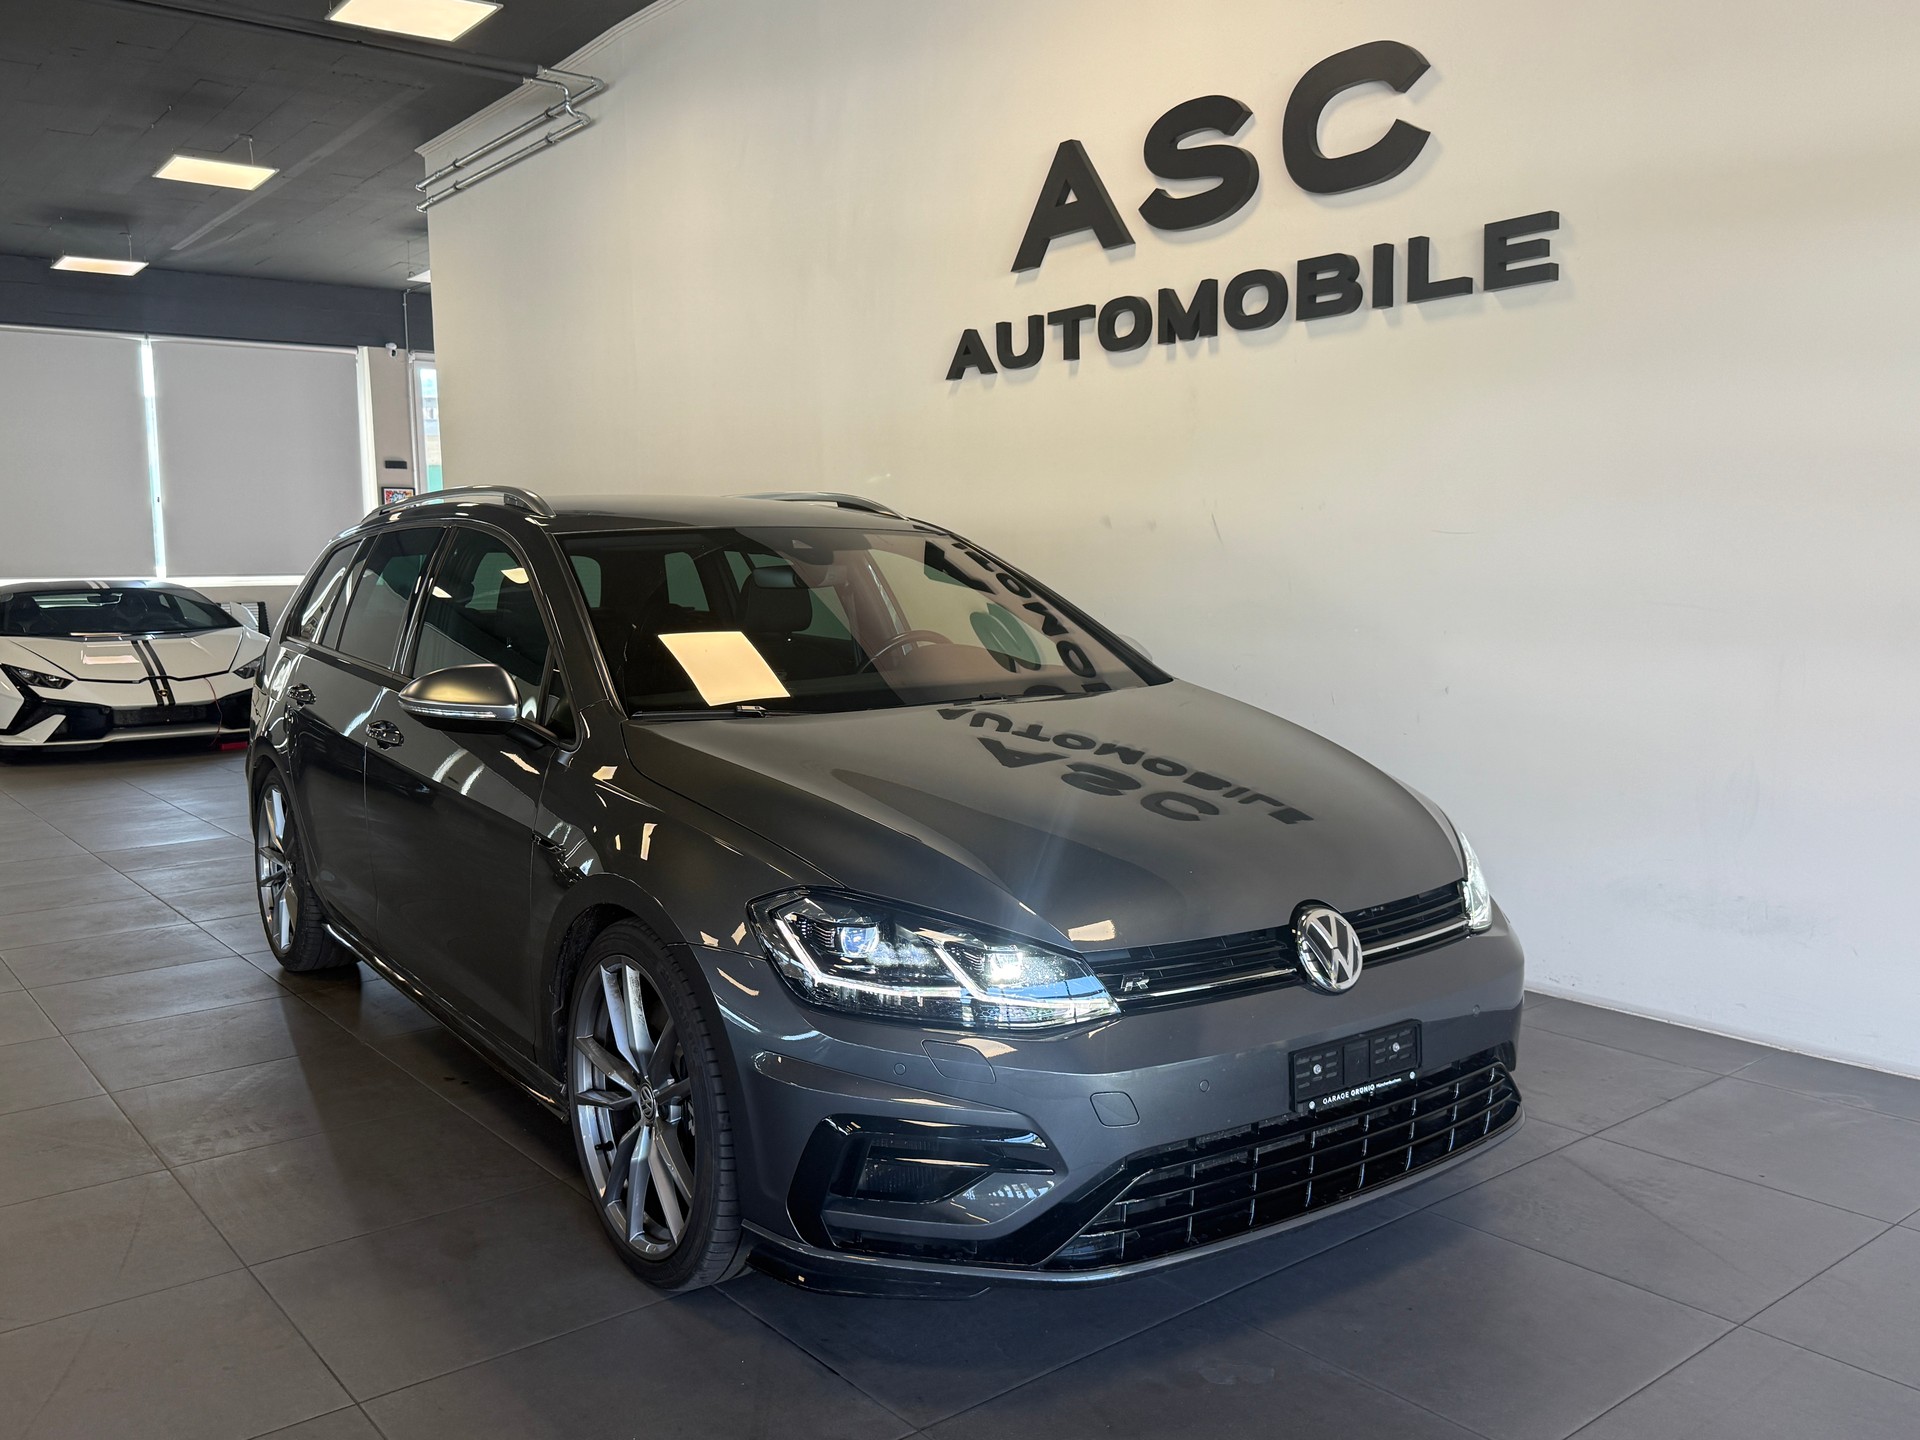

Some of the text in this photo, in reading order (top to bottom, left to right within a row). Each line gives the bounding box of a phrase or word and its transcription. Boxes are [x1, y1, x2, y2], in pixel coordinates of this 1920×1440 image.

[1011, 40, 1431, 273] ASC
[945, 210, 1559, 381] AUTOMOBILE
[1323, 1092, 1349, 1104] GARAGE
